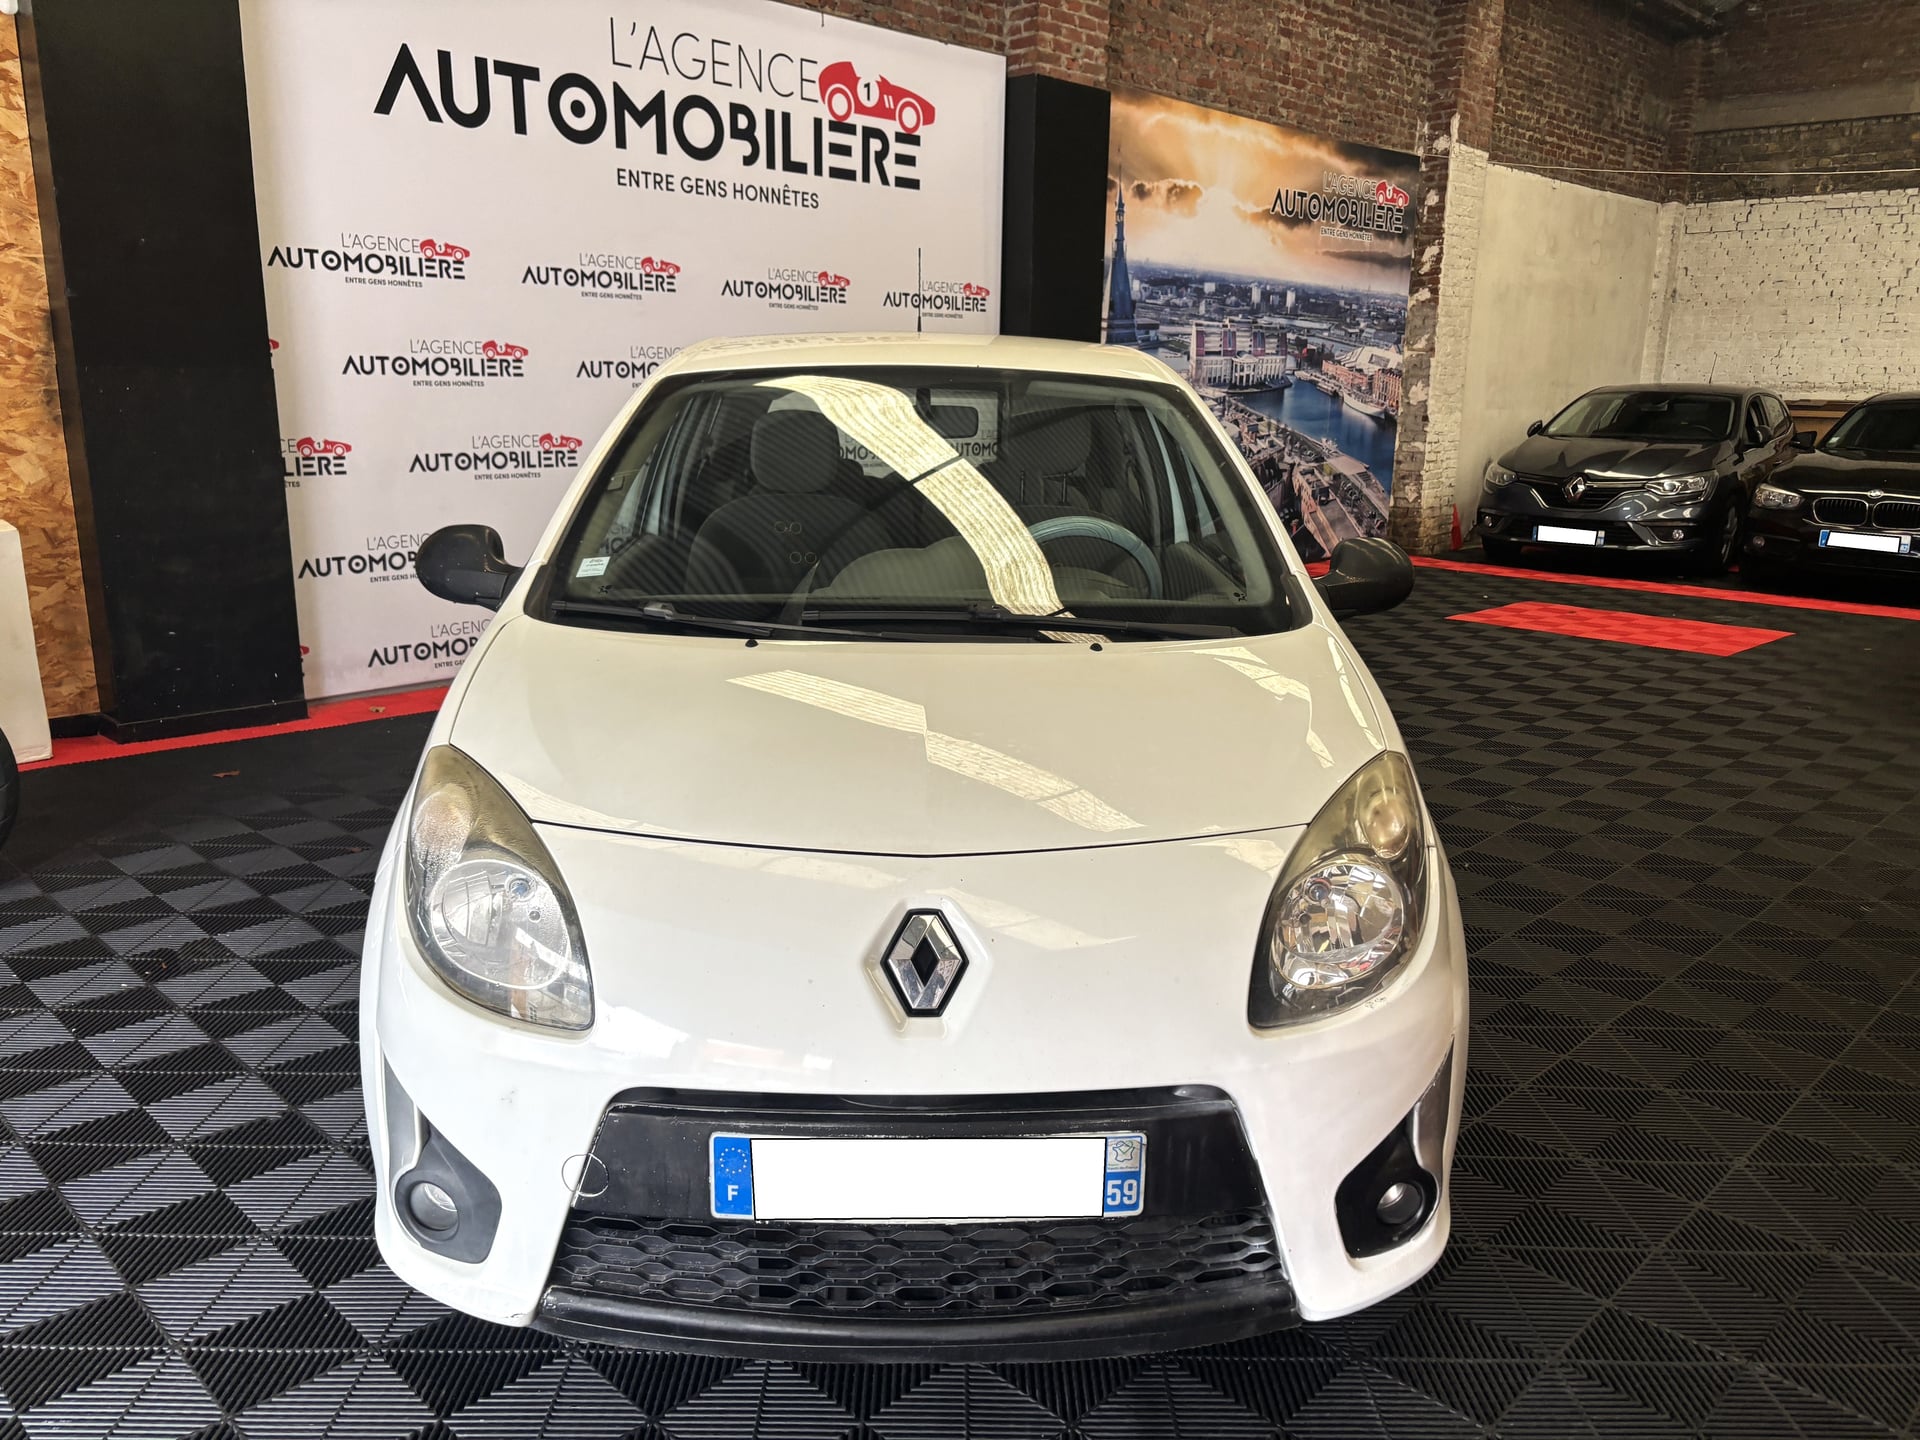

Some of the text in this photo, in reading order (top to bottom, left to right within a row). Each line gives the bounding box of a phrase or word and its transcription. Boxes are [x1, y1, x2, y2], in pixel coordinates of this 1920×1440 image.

[610, 17, 819, 103] L'AGENCE
[373, 43, 921, 190] AUTOMOBILIERE
[617, 168, 819, 209] ENTRE GENS HONNÊTES
[341, 232, 421, 254] L'AGENCE
[267, 246, 466, 280] AUTOMOBILIERE
[345, 276, 367, 284] ENTRE
[368, 278, 386, 286] GENS
[522, 265, 677, 293] AUTOMOBILIERE
[410, 338, 483, 355] L'AGENCE
[342, 355, 524, 377] AUTOMOBILIERE
[472, 434, 540, 449] L'AGENCE
[409, 450, 578, 473] AUTOMOBILIERE
[370, 575, 390, 583] ENTRE
[431, 618, 492, 638] L'AGENC
[727, 1185, 739, 1201] F
[1106, 1179, 1138, 1206] 59
